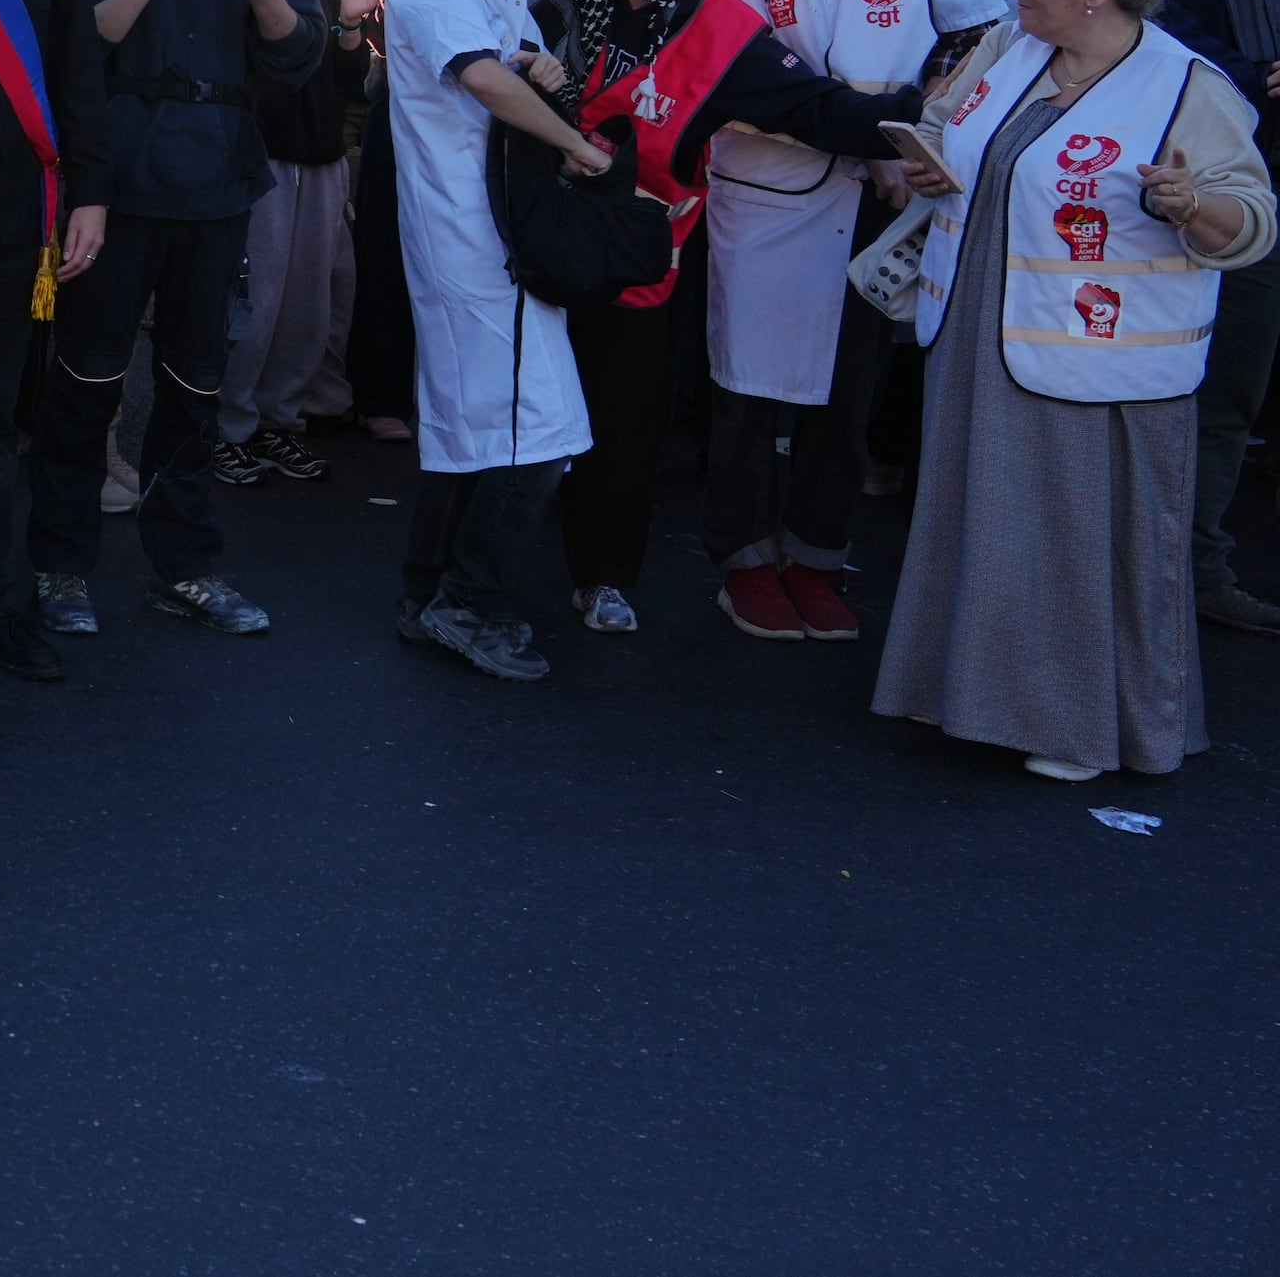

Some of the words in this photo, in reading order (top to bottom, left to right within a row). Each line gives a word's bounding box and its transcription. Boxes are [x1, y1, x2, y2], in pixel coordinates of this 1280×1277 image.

[866, 6, 900, 28] cgt
[1056, 178, 1098, 201] cgt
[1070, 221, 1102, 237] cgt
[1090, 323, 1112, 333] cgt
